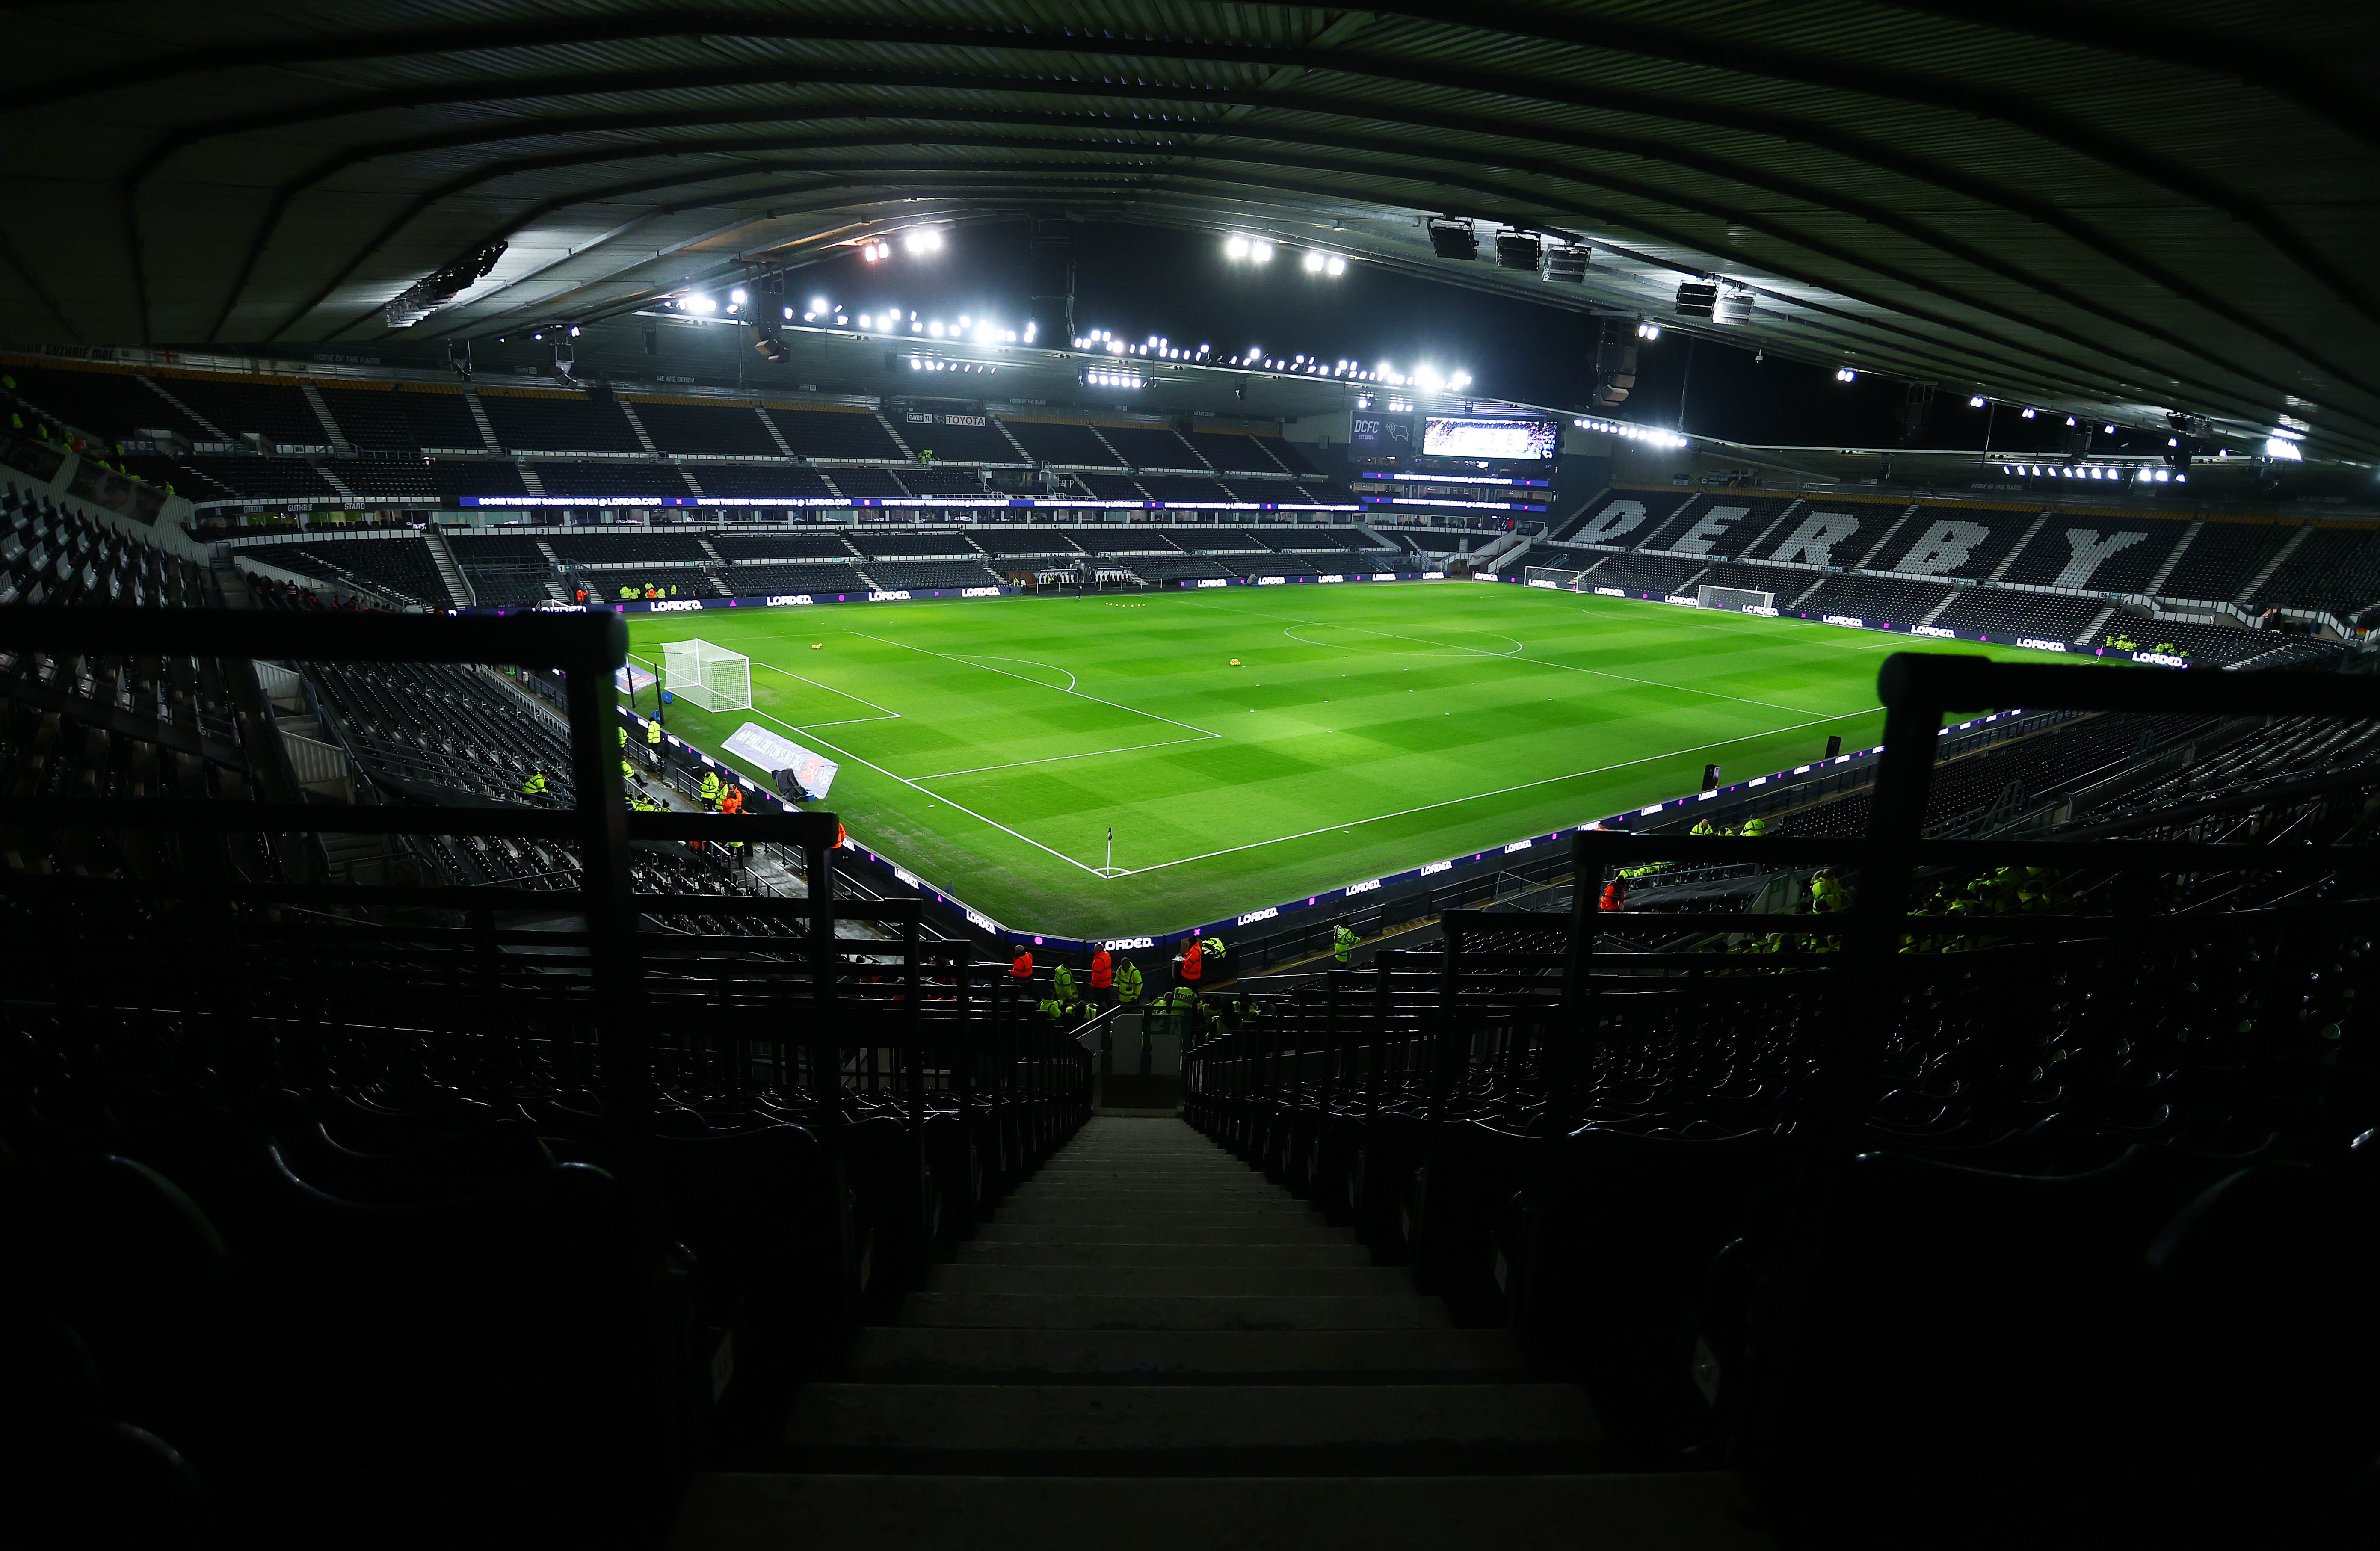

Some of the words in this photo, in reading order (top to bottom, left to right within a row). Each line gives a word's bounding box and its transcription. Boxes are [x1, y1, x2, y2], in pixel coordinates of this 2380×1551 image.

[947, 416, 984, 425] TOYOTA
[1354, 420, 1379, 433] DCFC
[1569, 499, 2148, 589] DERBY
[767, 595, 814, 606] LOADED.
[869, 590, 911, 601] LOADED.
[651, 600, 703, 612] LOADED.
[1823, 615, 1863, 627] LOADED.
[1911, 625, 1955, 638] LOADED.
[2016, 637, 2066, 652] LOADED.
[803, 761, 819, 781] bet
[1421, 861, 1452, 876] LOADED.
[894, 867, 919, 890] LOADED.
[1346, 879, 1381, 896] LOADED.
[966, 910, 996, 935] LOADED.
[1238, 907, 1279, 926] LOADED.
